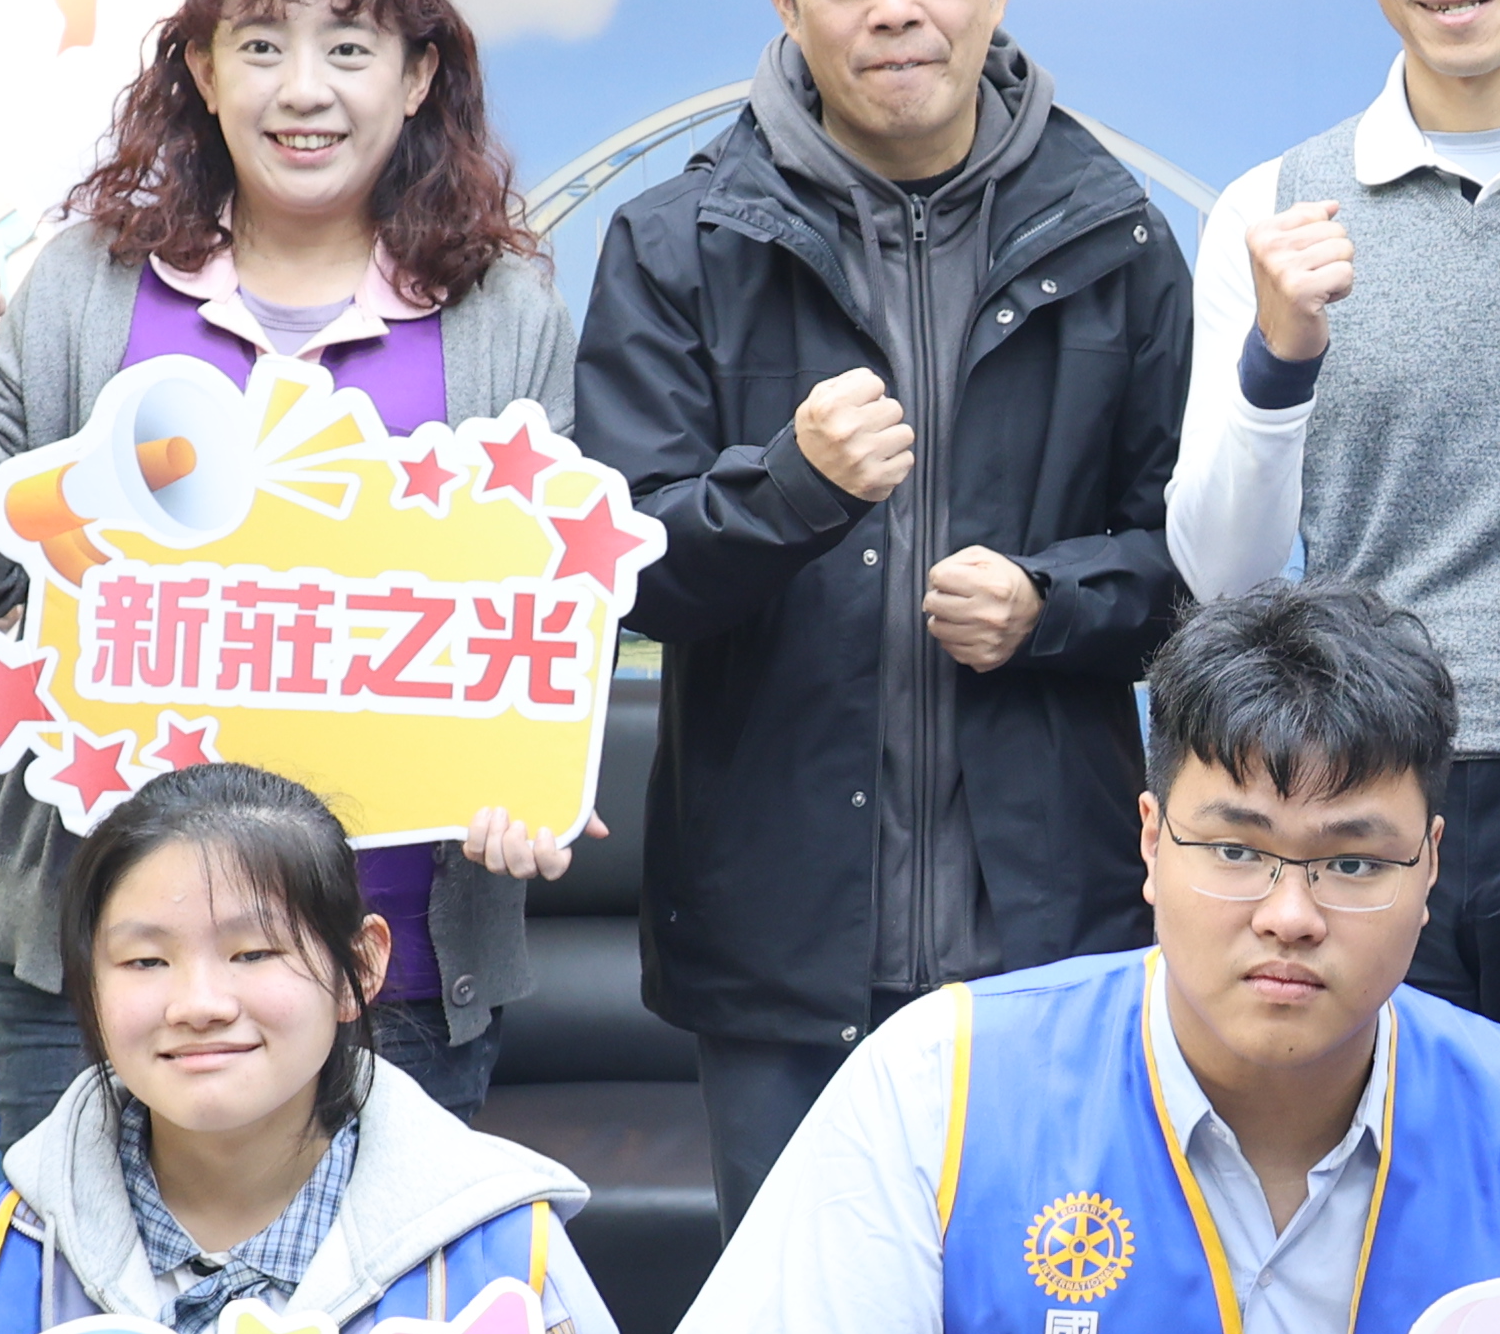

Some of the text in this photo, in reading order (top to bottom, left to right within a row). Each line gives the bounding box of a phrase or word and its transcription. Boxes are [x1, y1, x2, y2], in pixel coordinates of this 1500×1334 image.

[91, 575, 579, 706] 新莊之光
[1059, 1204, 1105, 1218] ROTARY
[1039, 1261, 1118, 1292] INTERNATIONAL
